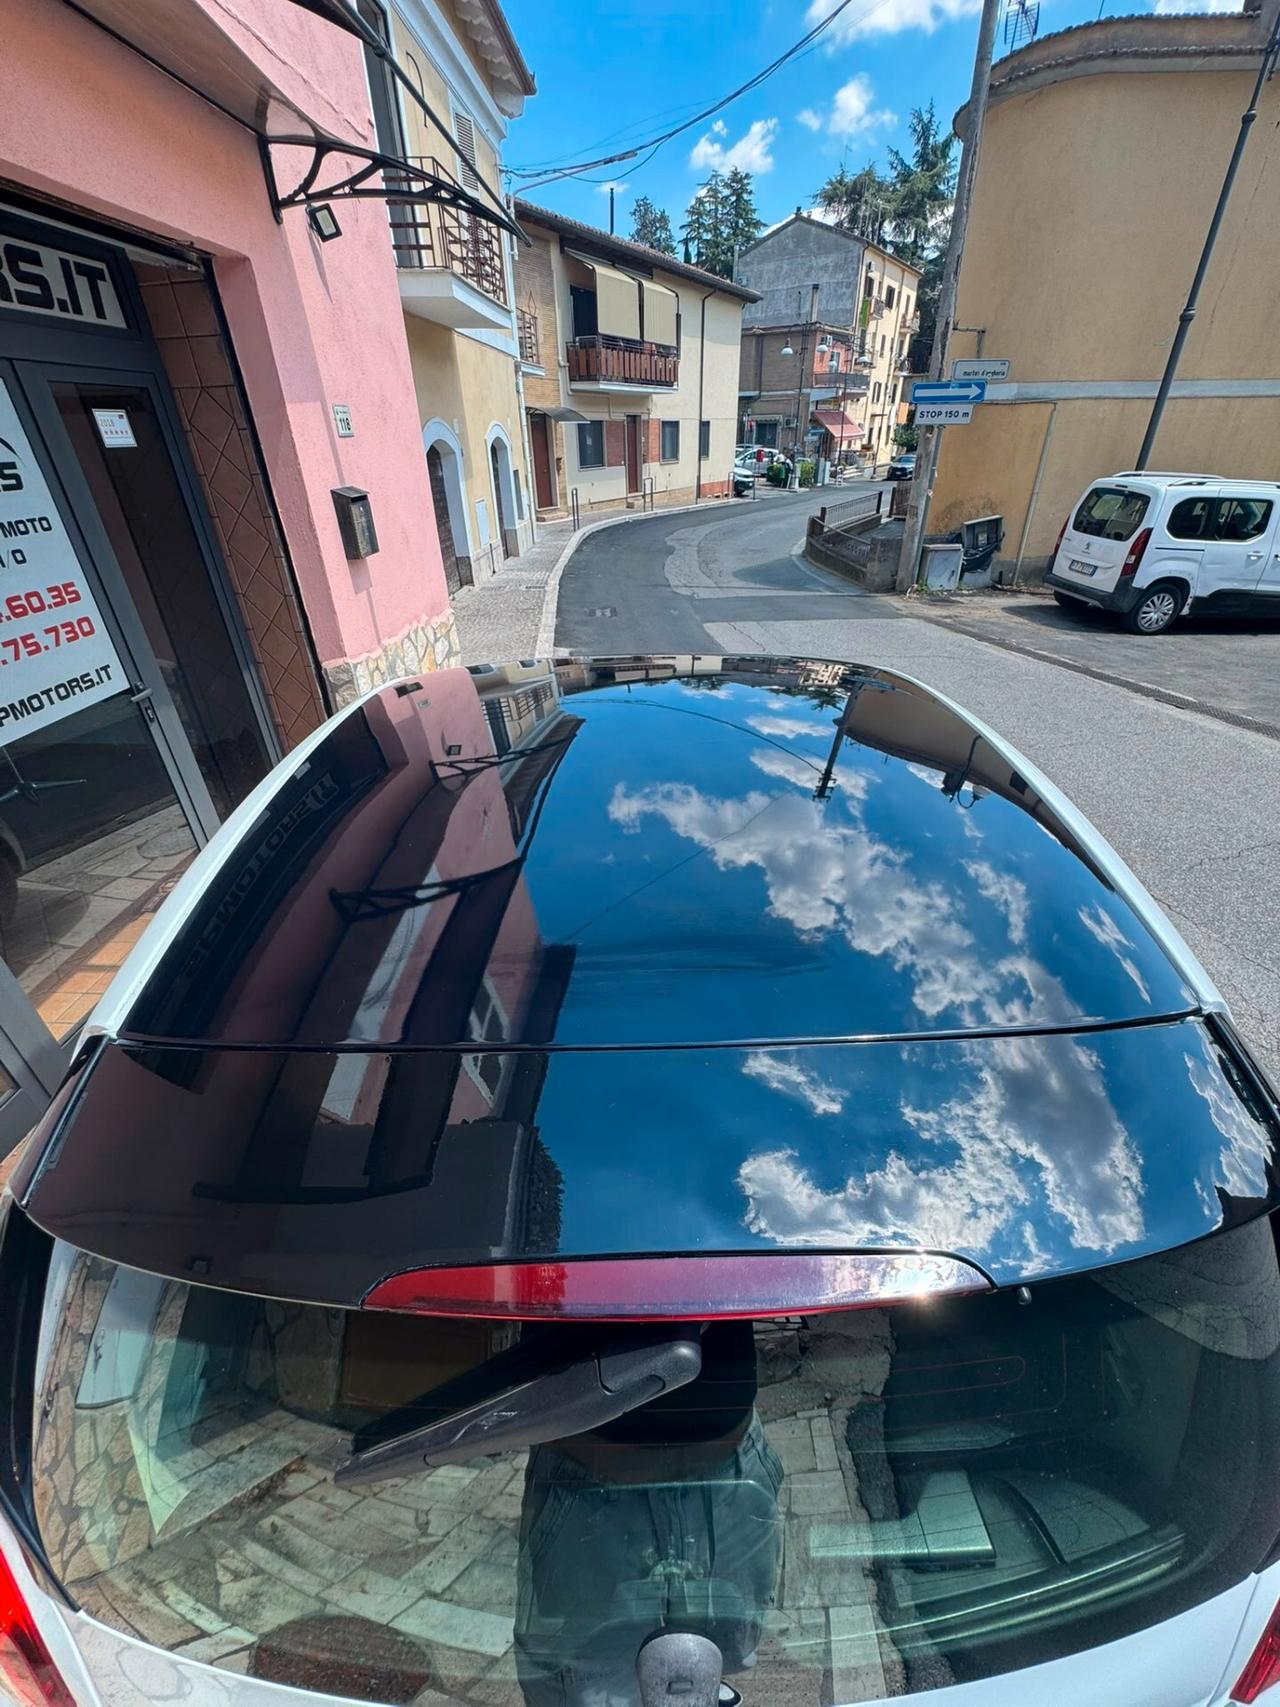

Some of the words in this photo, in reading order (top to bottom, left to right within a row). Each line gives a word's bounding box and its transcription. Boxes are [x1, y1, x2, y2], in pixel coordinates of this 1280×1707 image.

[919, 410, 942, 419] STOP
[944, 410, 959, 418] 150
[0, 462, 24, 492] S
[0, 516, 52, 538] MOTO
[0, 581, 82, 623] .60.35
